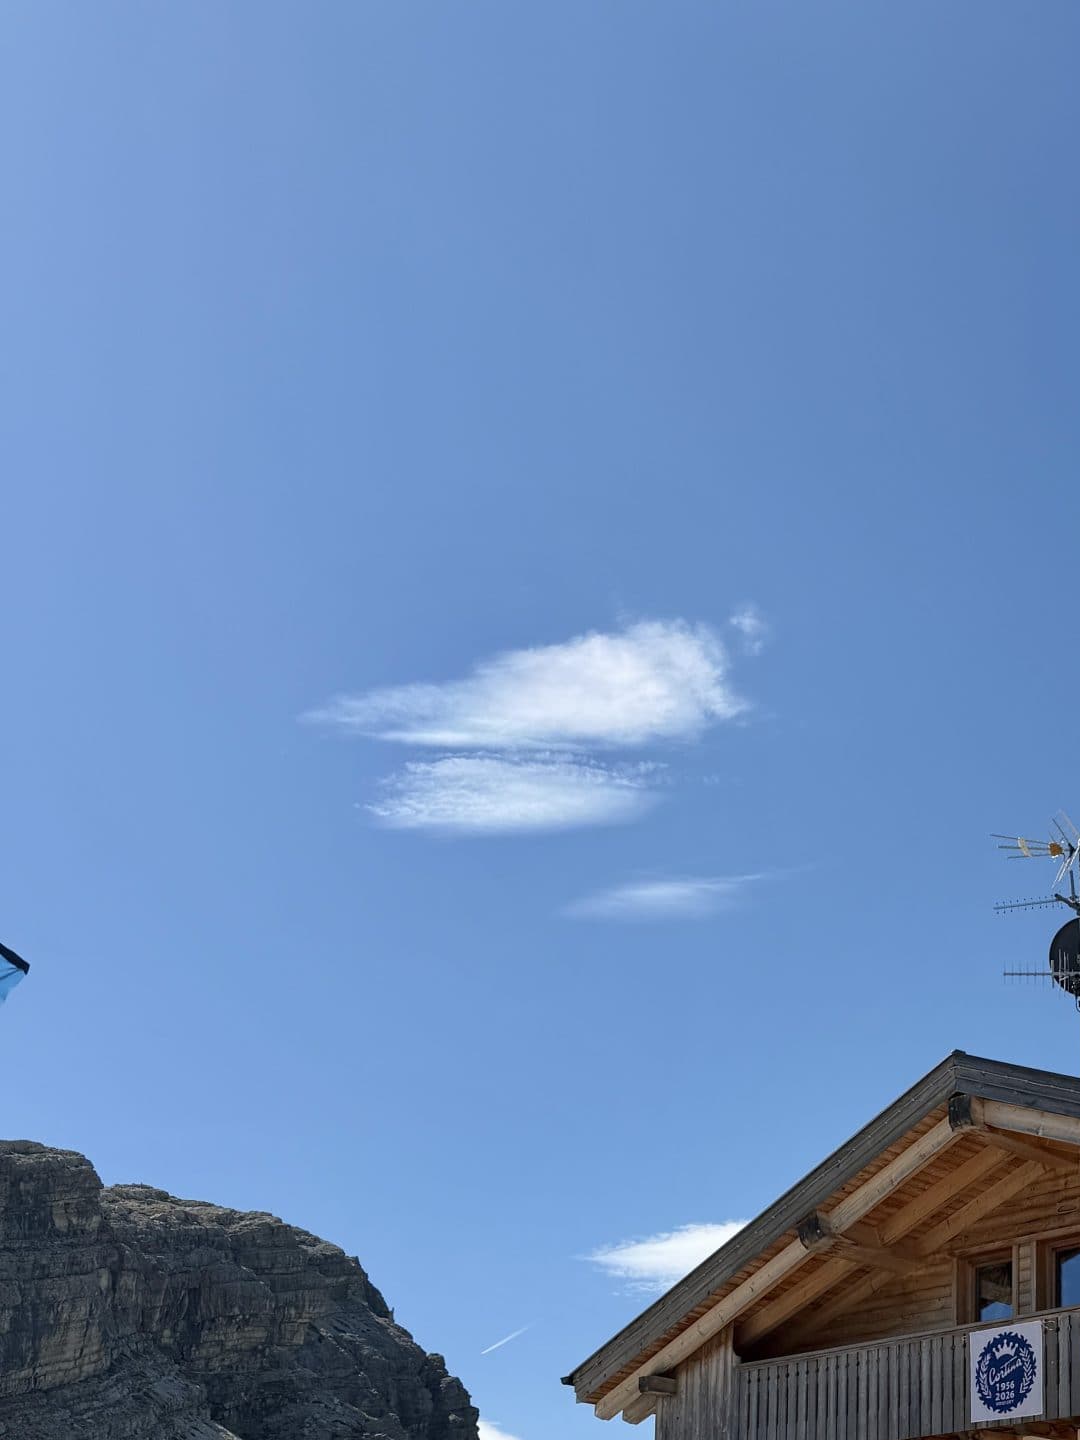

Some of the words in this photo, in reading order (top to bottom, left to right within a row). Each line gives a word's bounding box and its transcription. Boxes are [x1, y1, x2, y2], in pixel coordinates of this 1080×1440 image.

[989, 1355, 1023, 1386] Cortina
[996, 1380, 1015, 1391] 1956
[995, 1390, 1015, 1401] 2026
